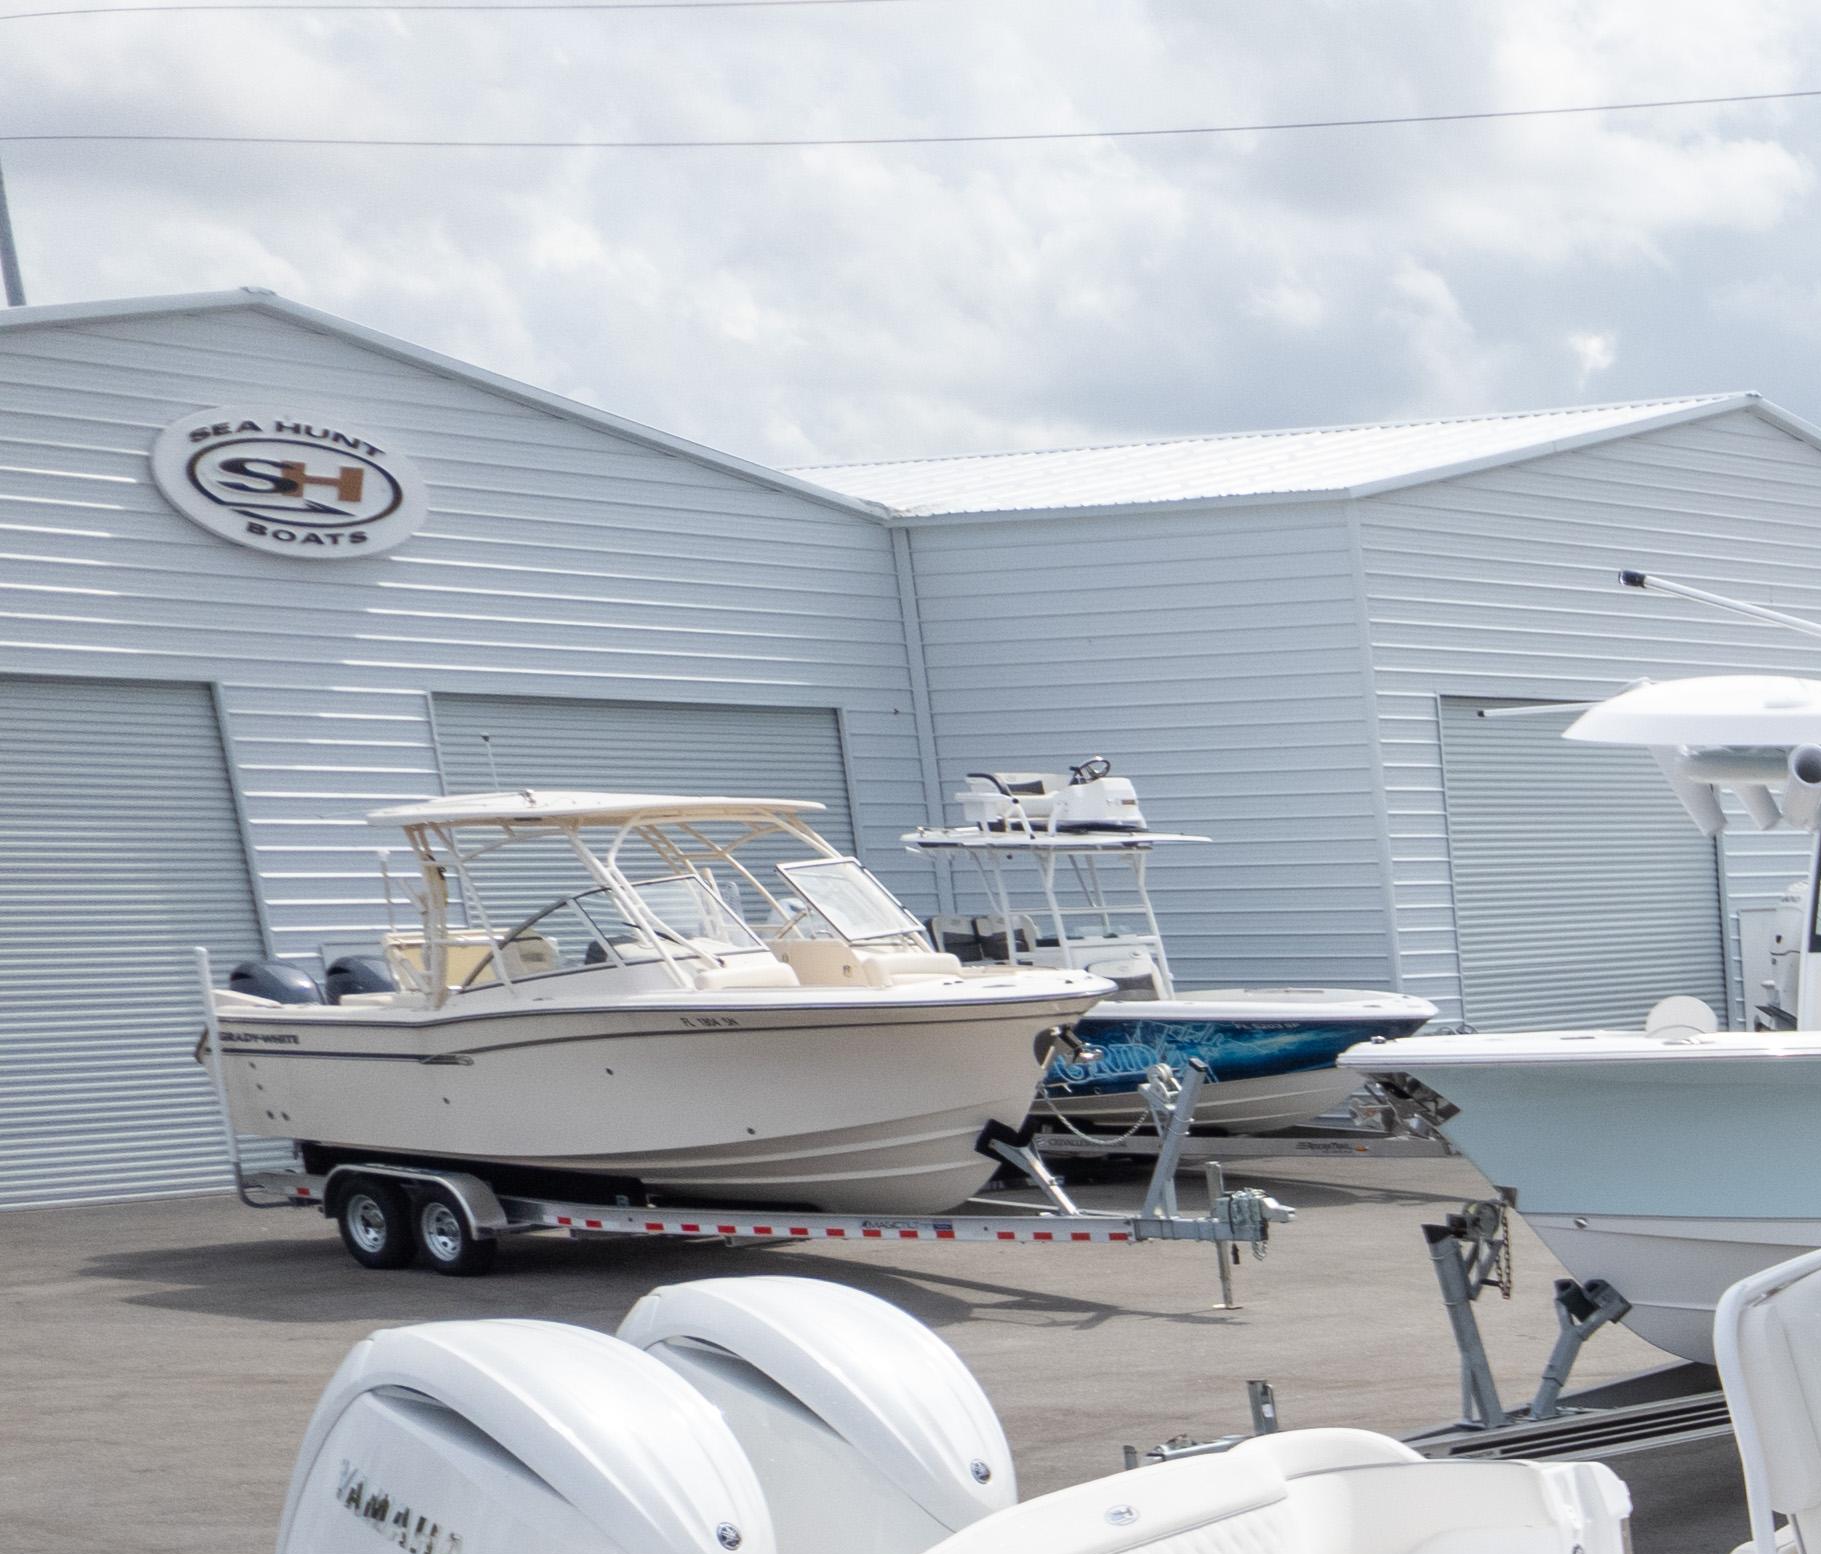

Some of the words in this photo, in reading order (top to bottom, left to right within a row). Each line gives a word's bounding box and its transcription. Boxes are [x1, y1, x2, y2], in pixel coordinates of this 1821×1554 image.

[189, 420, 263, 442] SEA
[275, 421, 386, 457] HUNT
[216, 457, 364, 502] SH
[247, 521, 368, 545] BOATS
